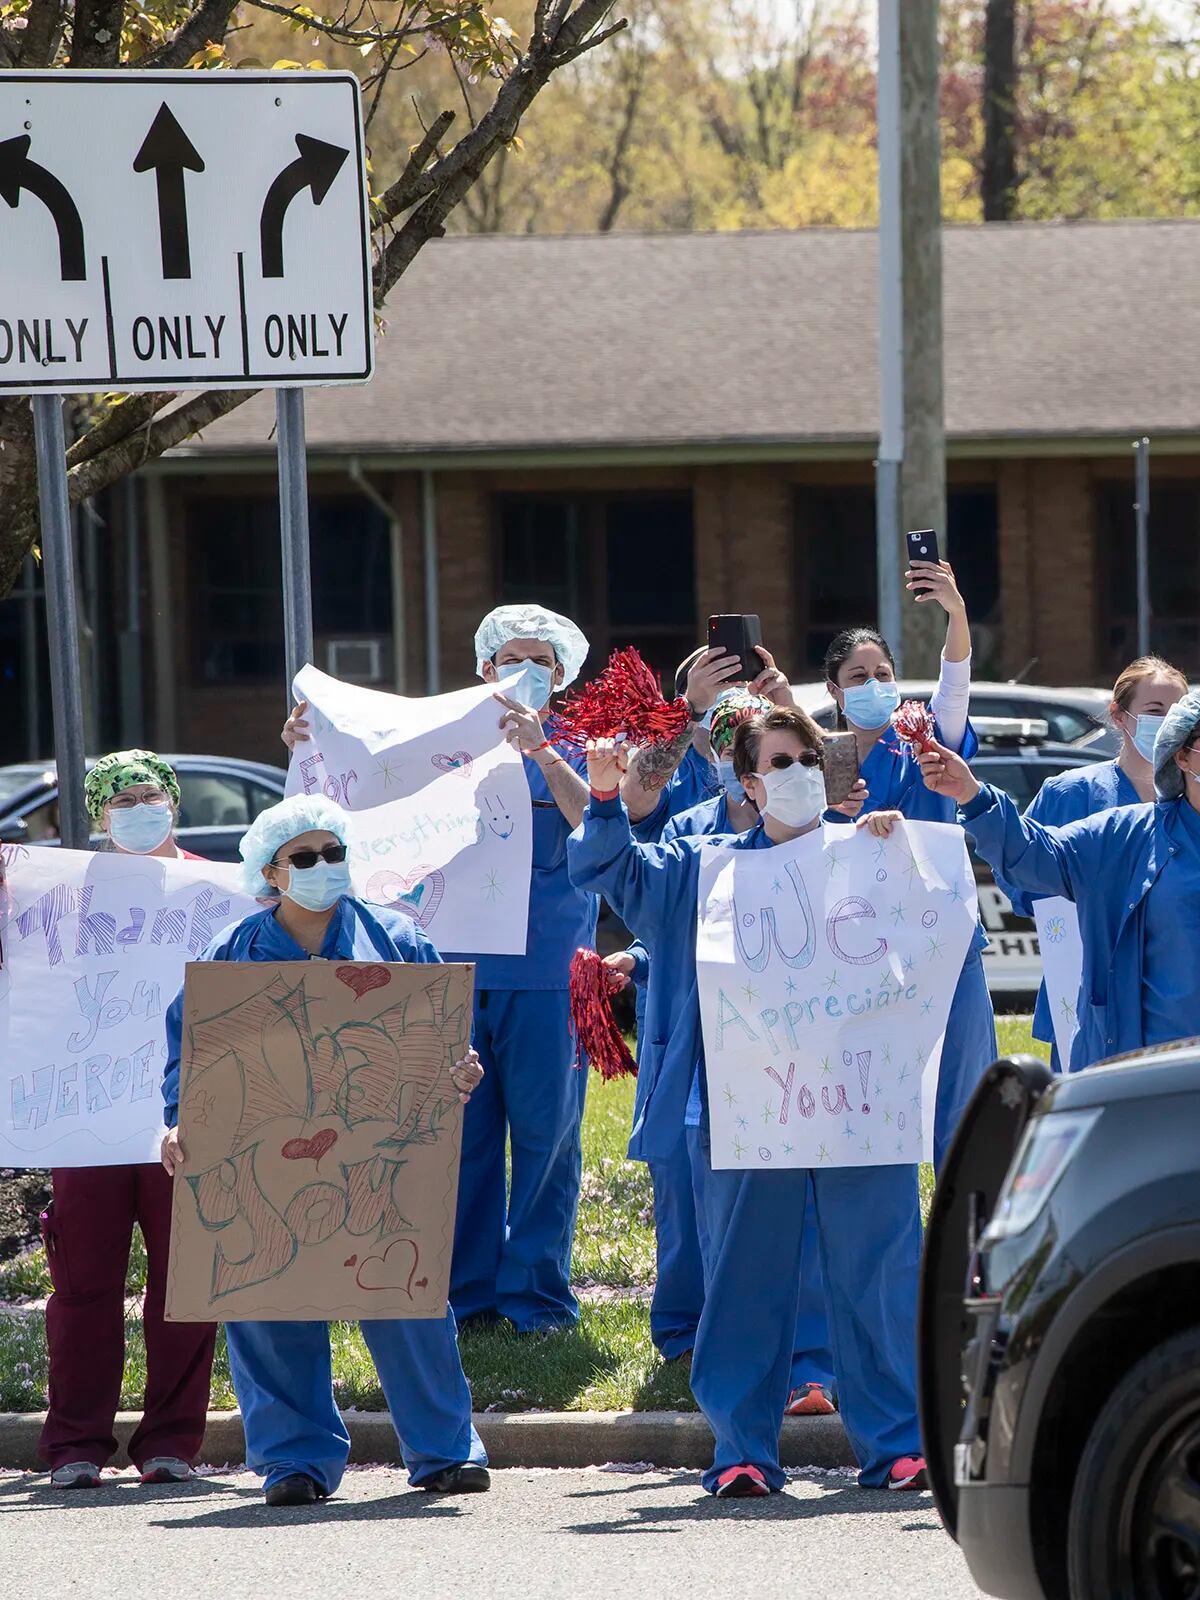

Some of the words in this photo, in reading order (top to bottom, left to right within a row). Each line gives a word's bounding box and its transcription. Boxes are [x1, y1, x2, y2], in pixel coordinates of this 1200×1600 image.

[0, 318, 88, 364] ONLY
[132, 315, 226, 361] ONLY
[264, 313, 348, 359] ONLY
[300, 752, 358, 807] For
[729, 860, 888, 973] We
[715, 983, 918, 1056] Appreciate
[10, 1040, 166, 1130] HEROE
[763, 1050, 873, 1125] You!
